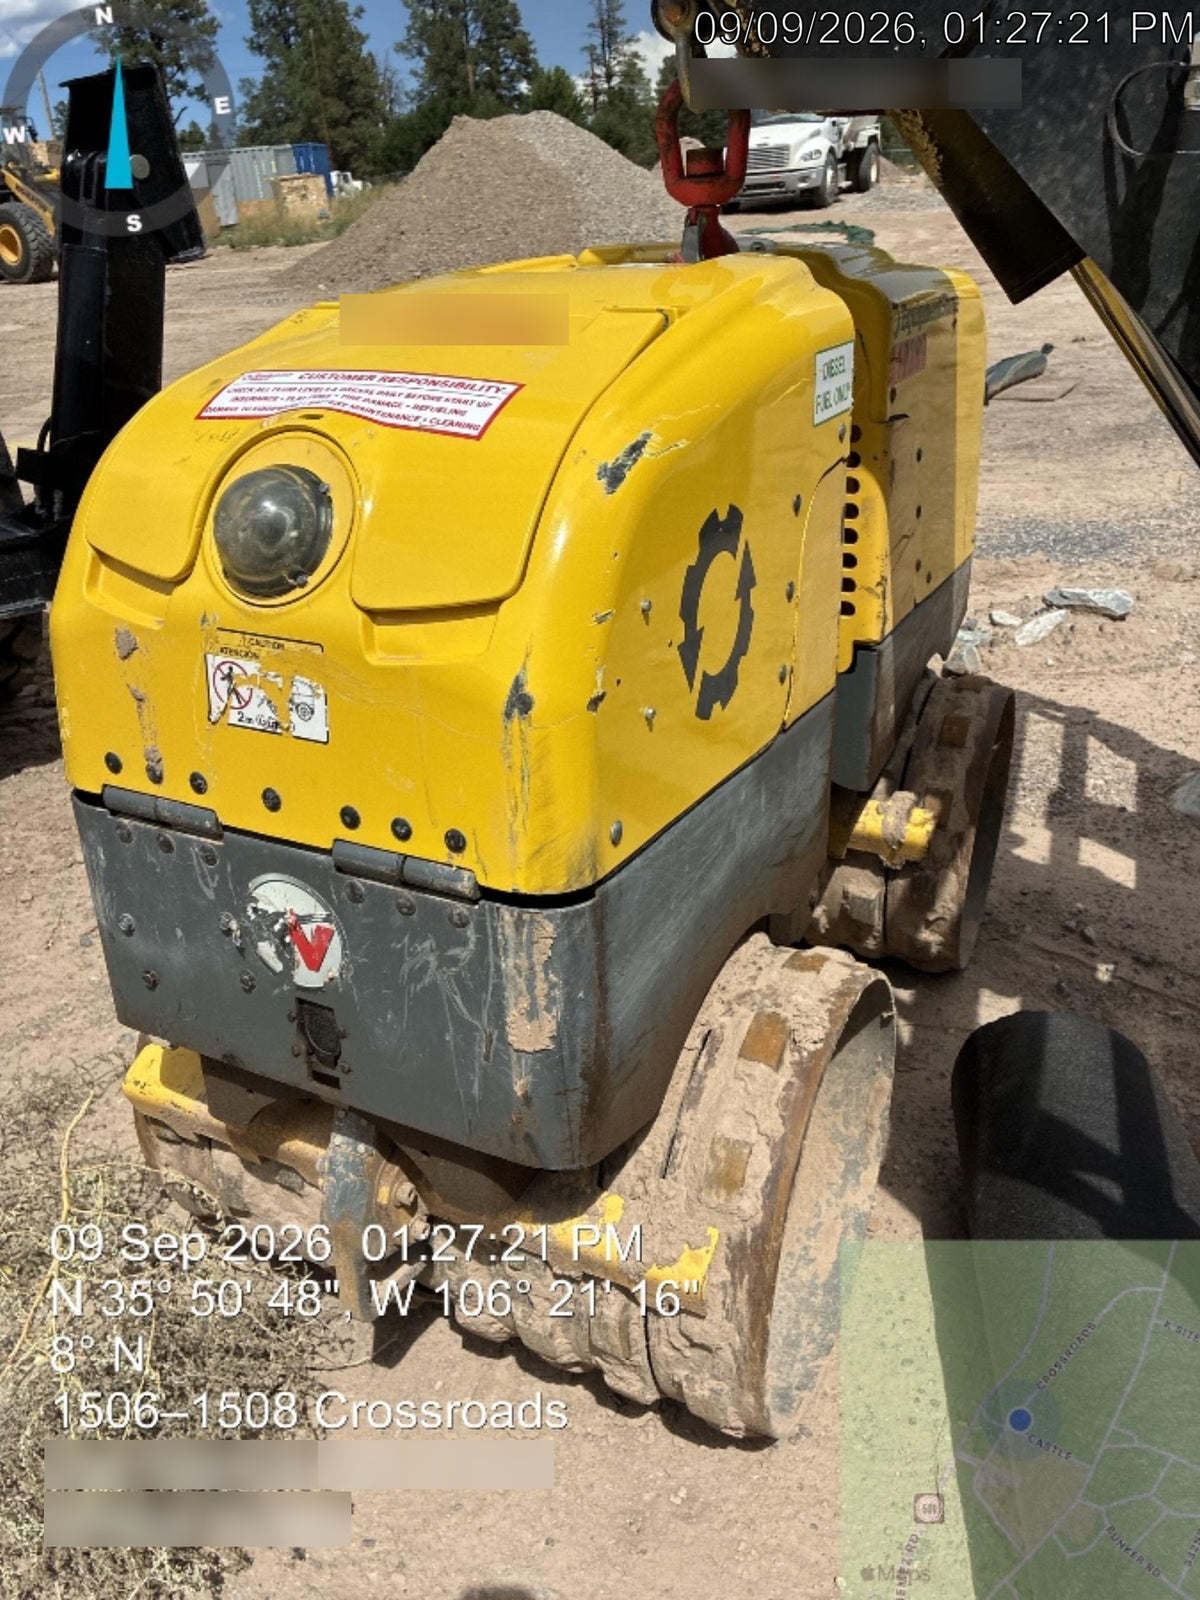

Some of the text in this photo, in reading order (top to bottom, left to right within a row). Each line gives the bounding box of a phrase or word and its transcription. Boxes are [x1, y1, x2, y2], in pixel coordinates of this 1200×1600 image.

[823, 355, 845, 380] DIESEL
[298, 372, 377, 382] CUSTOMER
[377, 375, 507, 394] RESPONSIBILITY
[404, 392, 444, 403] BEFORE
[816, 391, 833, 415] FUEL
[411, 404, 468, 417] REFUELING
[429, 417, 482, 432] CLEANING
